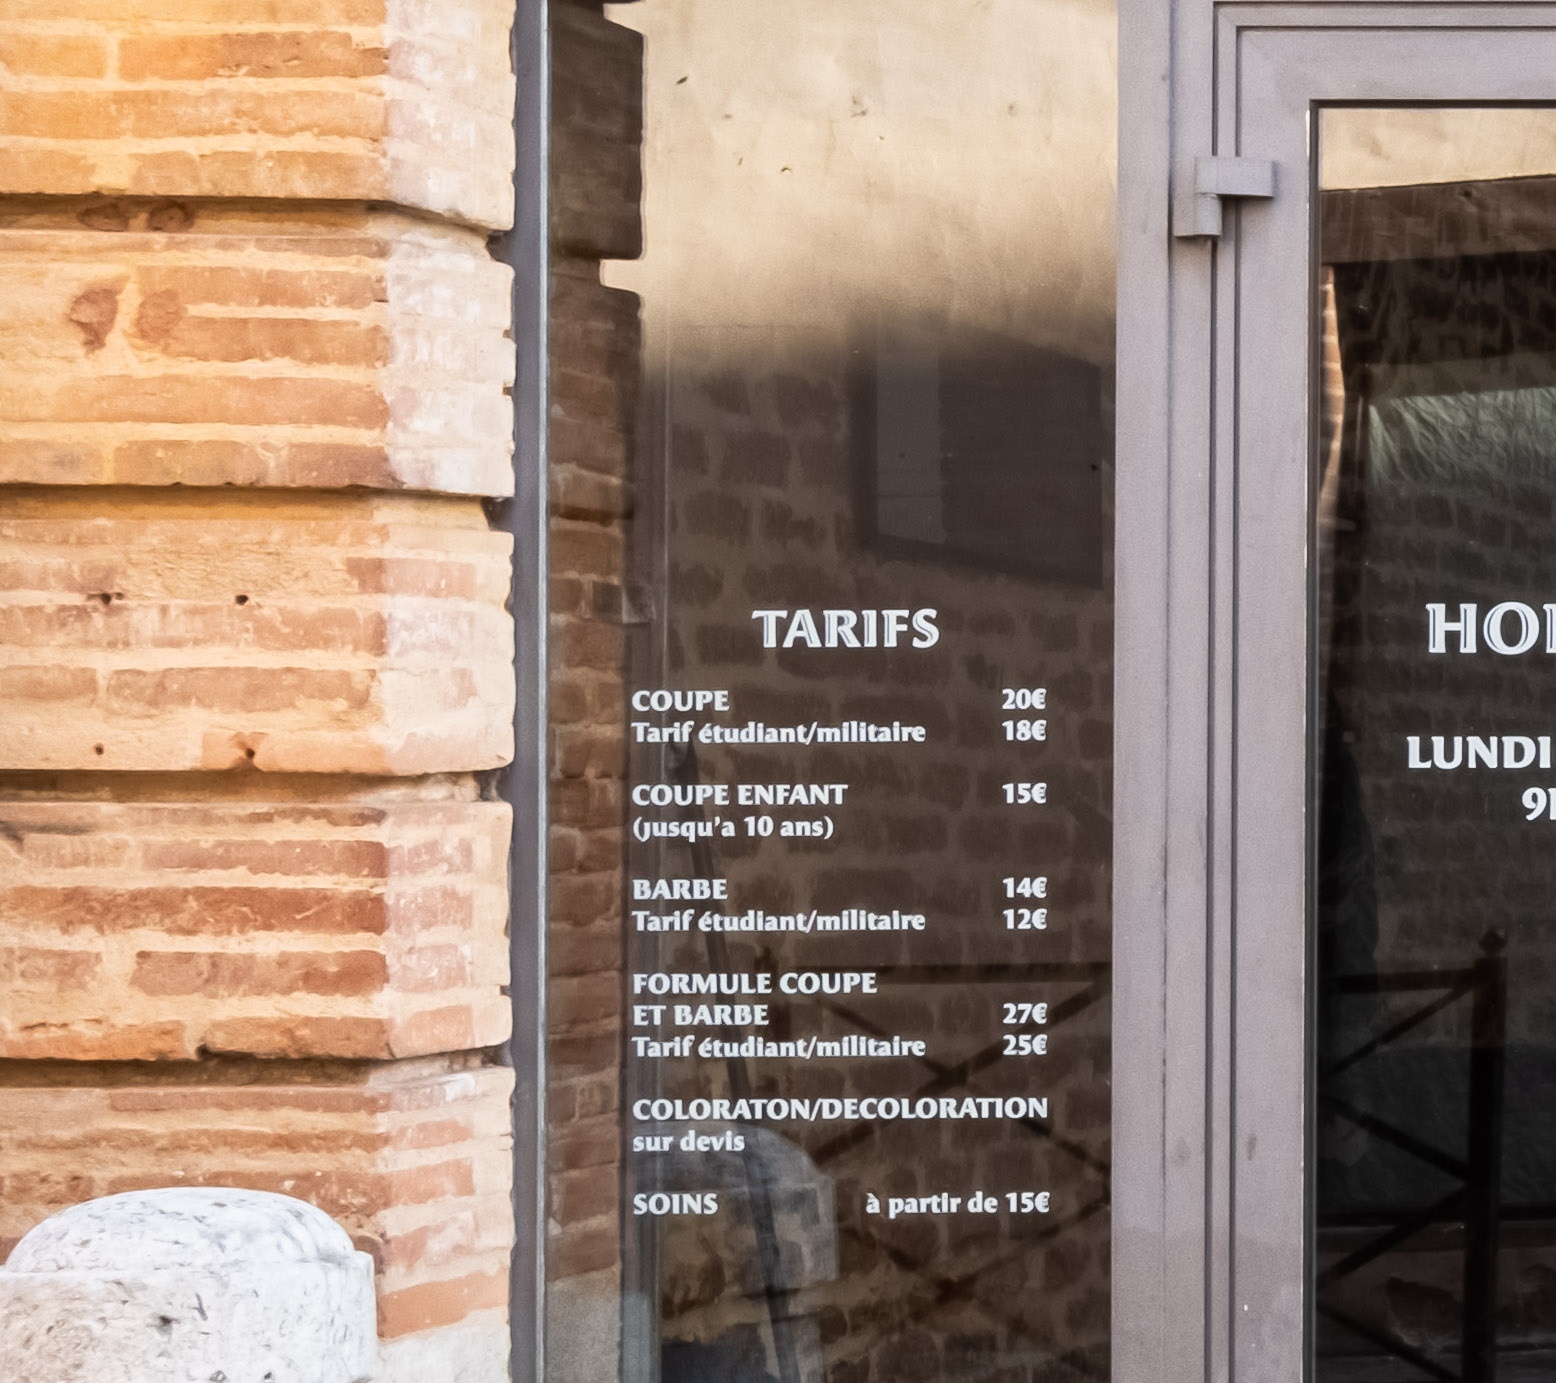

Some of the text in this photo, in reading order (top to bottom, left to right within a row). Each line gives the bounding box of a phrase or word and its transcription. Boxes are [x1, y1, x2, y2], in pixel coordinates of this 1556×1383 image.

[752, 609, 939, 648] TARIFS
[632, 688, 1046, 711] COUPE 20€
[631, 720, 1046, 745] Tarif étudiant/militaire 18€
[1407, 736, 1551, 769] LUNDI
[632, 783, 1047, 806] COUPE ENFANT 15€
[744, 816, 773, 836] 10
[780, 816, 833, 839] ans)
[633, 877, 1047, 899] BARBE 14€
[632, 908, 1047, 933] Tarif étudiant/militaire 12€
[633, 973, 877, 994] FORMULE COUPE
[633, 1003, 1047, 1026] ET BARBE 27€
[631, 1034, 1047, 1059] Tarif étudiant/militaire 25€
[633, 1097, 1048, 1124] COLORATON/DECOLORATION
[632, 1128, 746, 1153] sur devis
[634, 1191, 1050, 1219] SOINS à partir de 15€
